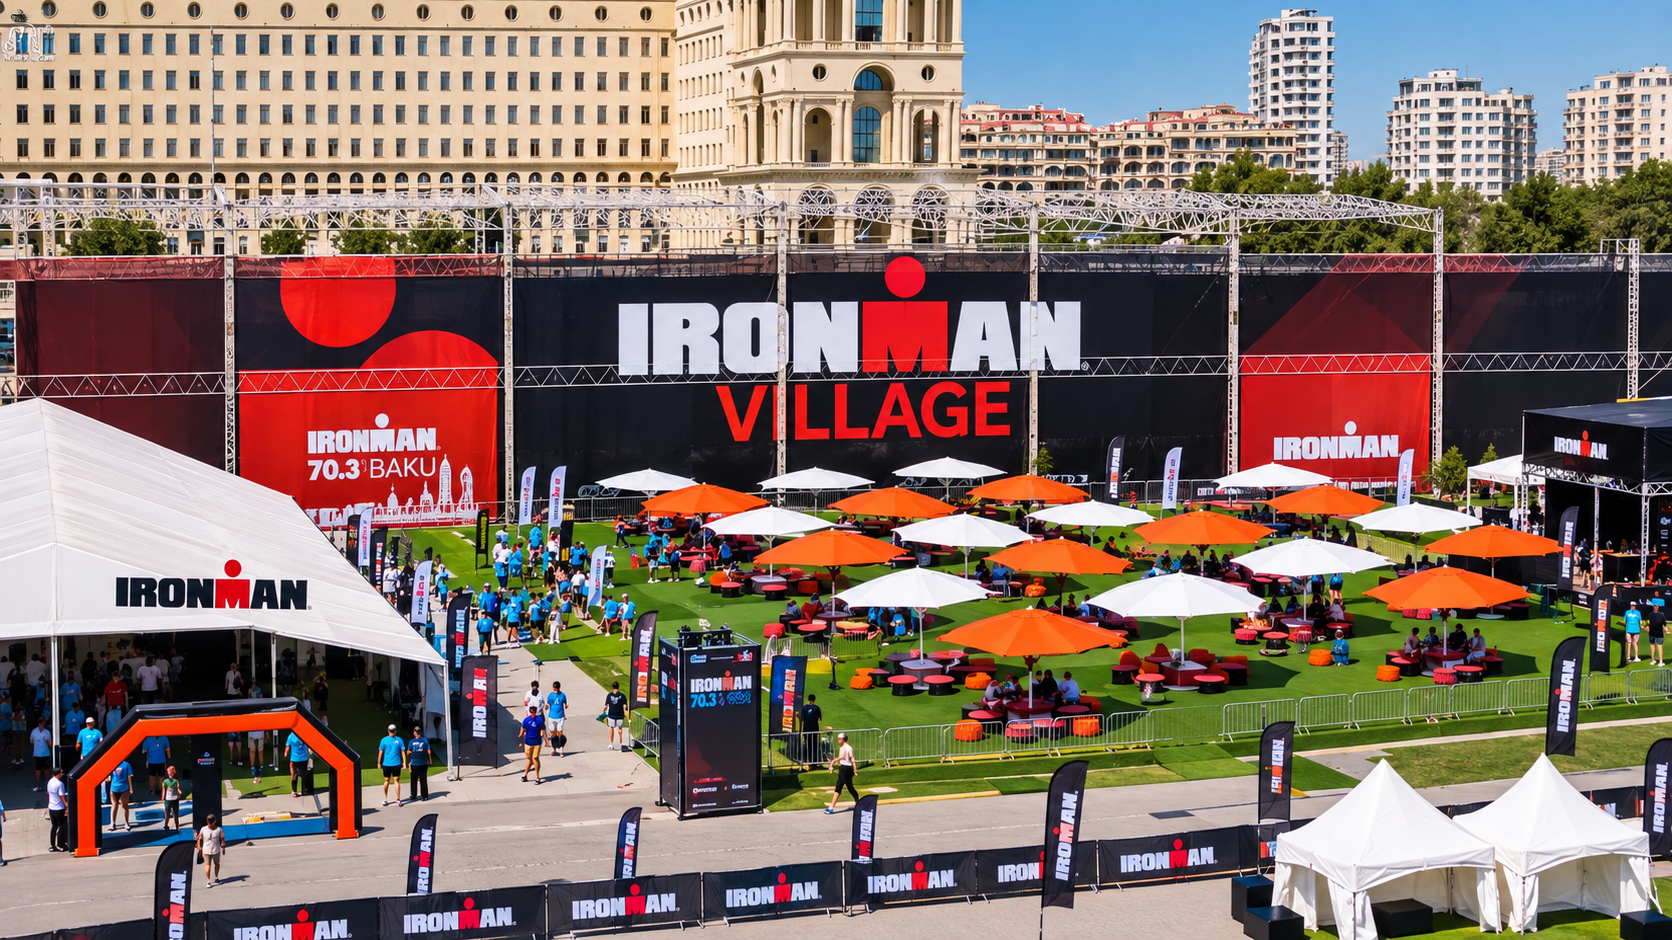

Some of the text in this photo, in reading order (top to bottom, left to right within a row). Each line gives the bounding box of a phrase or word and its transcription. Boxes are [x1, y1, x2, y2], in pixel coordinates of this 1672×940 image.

[618, 300, 1081, 375] IRONMAN
[307, 427, 437, 453] IRONMAN
[1273, 434, 1399, 460] IRONMAN
[1553, 436, 1609, 460] IRONMAN
[308, 456, 437, 481] 70.3 BAKU
[115, 576, 308, 611] IRONMAN
[690, 675, 752, 693] IRONMAN
[690, 692, 717, 708] 70.3
[1120, 846, 1215, 874] IRONMAN
[867, 869, 955, 894] IRONMAN
[998, 864, 1046, 883] IRON
[169, 873, 187, 940] OMAN
[572, 892, 676, 920] IRONMAN
[725, 881, 819, 908] IRONMAN
[233, 918, 349, 940] IRONMAN
[404, 907, 513, 934] IRONMAN
